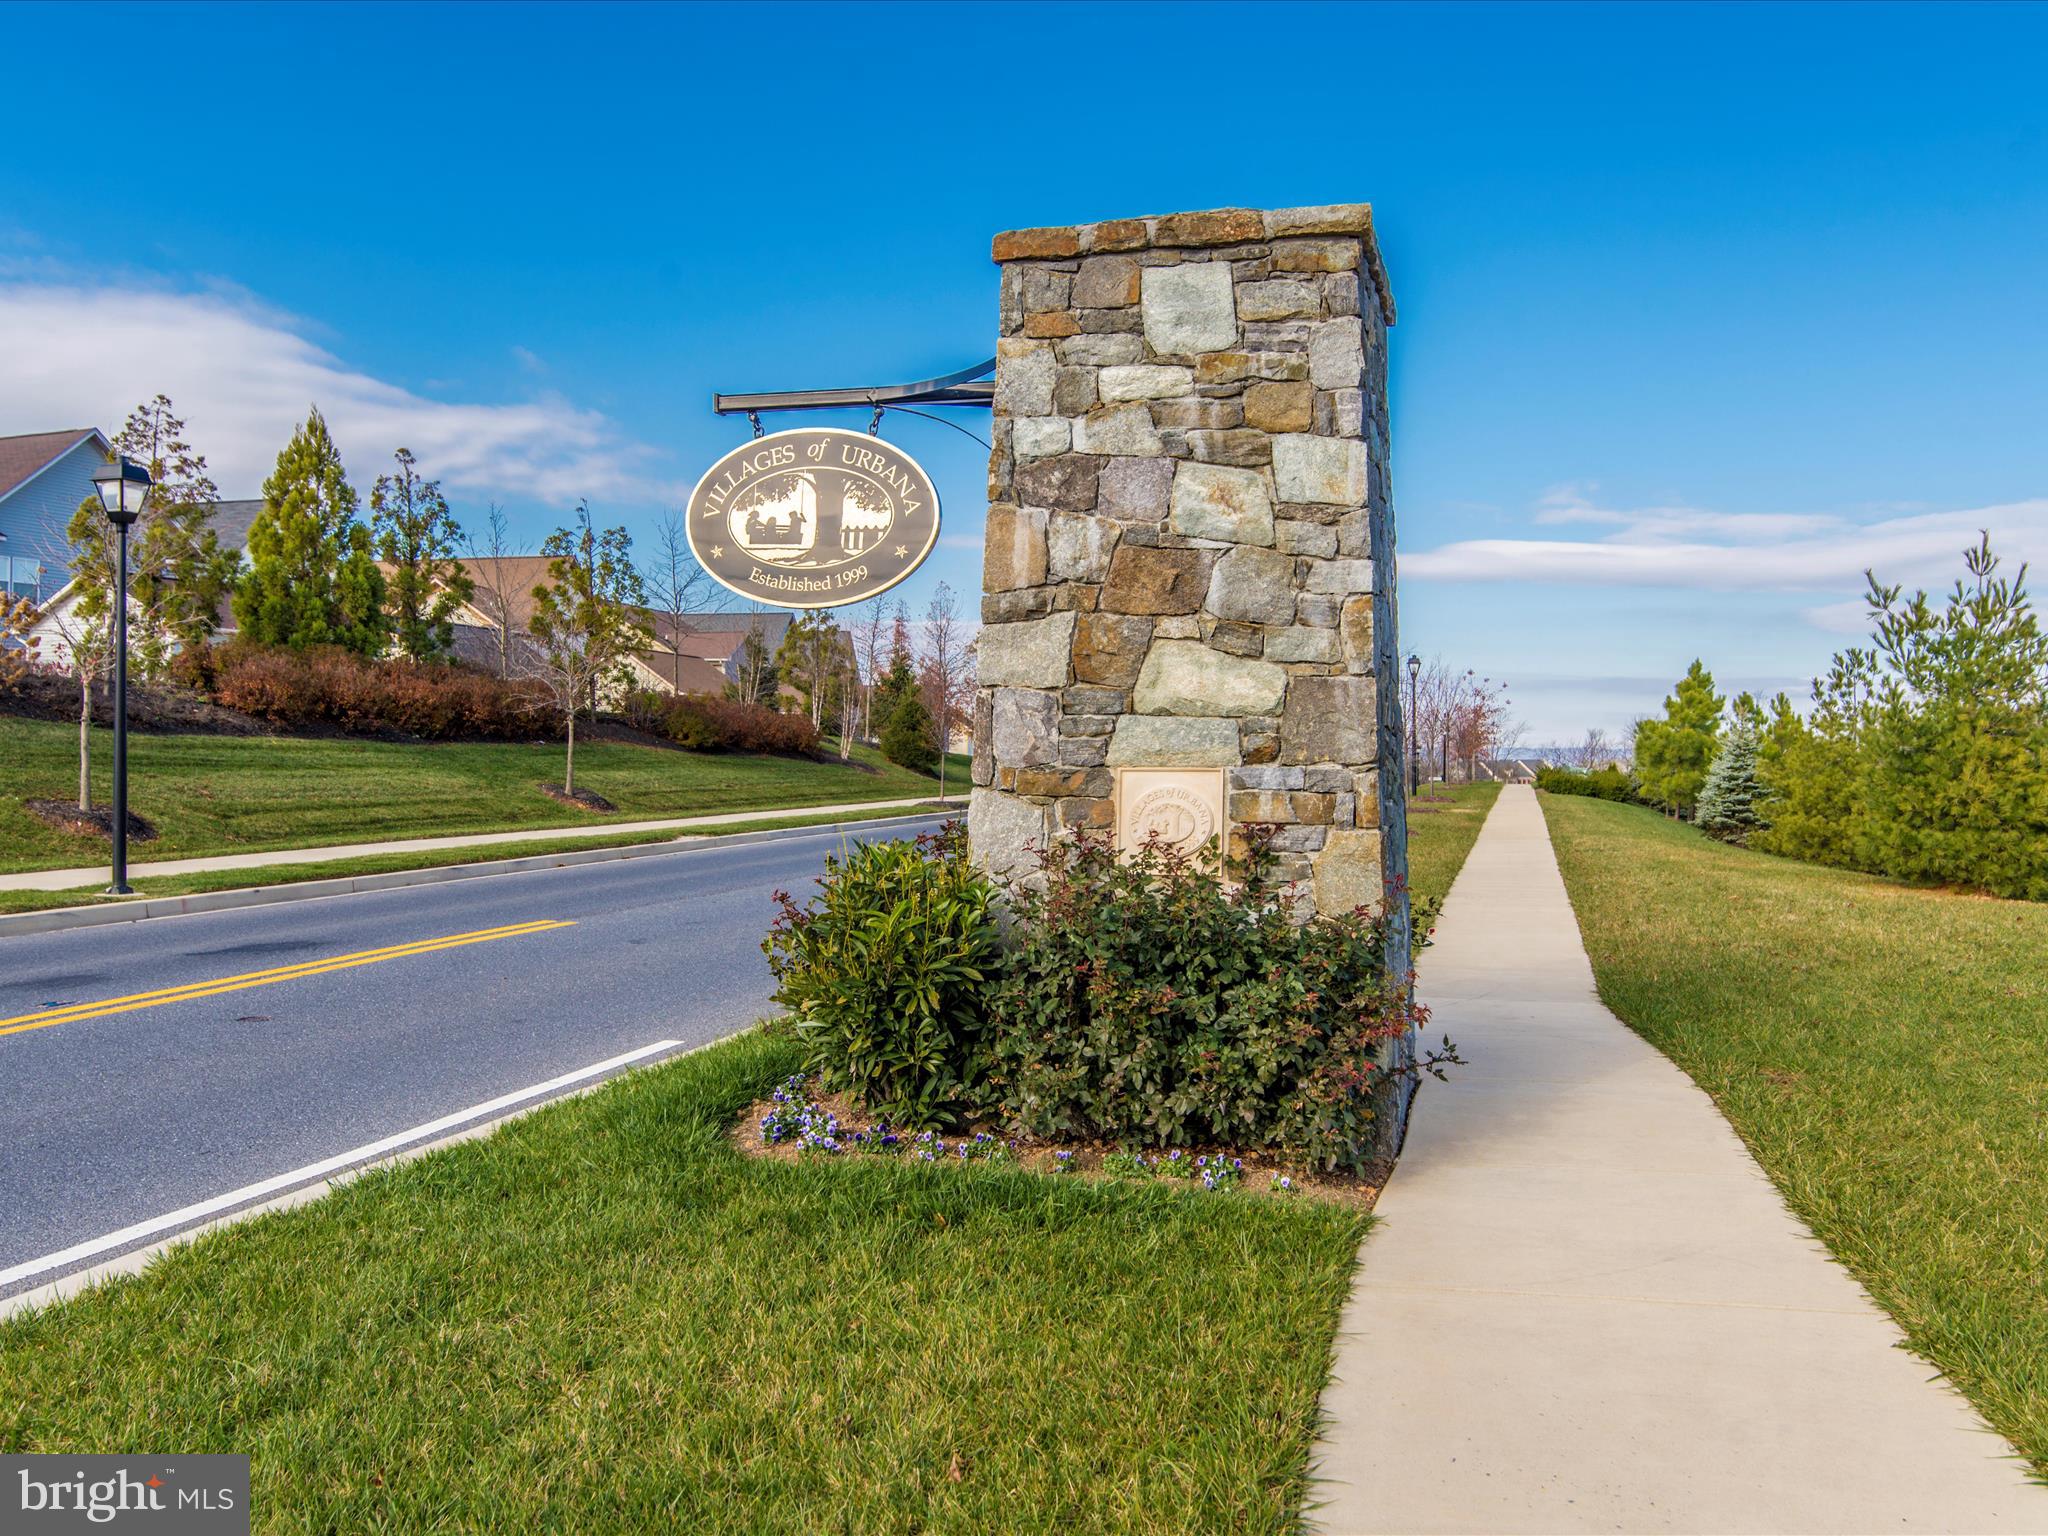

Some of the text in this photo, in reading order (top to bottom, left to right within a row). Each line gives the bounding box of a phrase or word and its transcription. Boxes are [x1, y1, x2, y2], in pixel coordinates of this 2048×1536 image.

[703, 438, 921, 519] VILLAGES of URBANA
[748, 565, 869, 592] Established 1999
